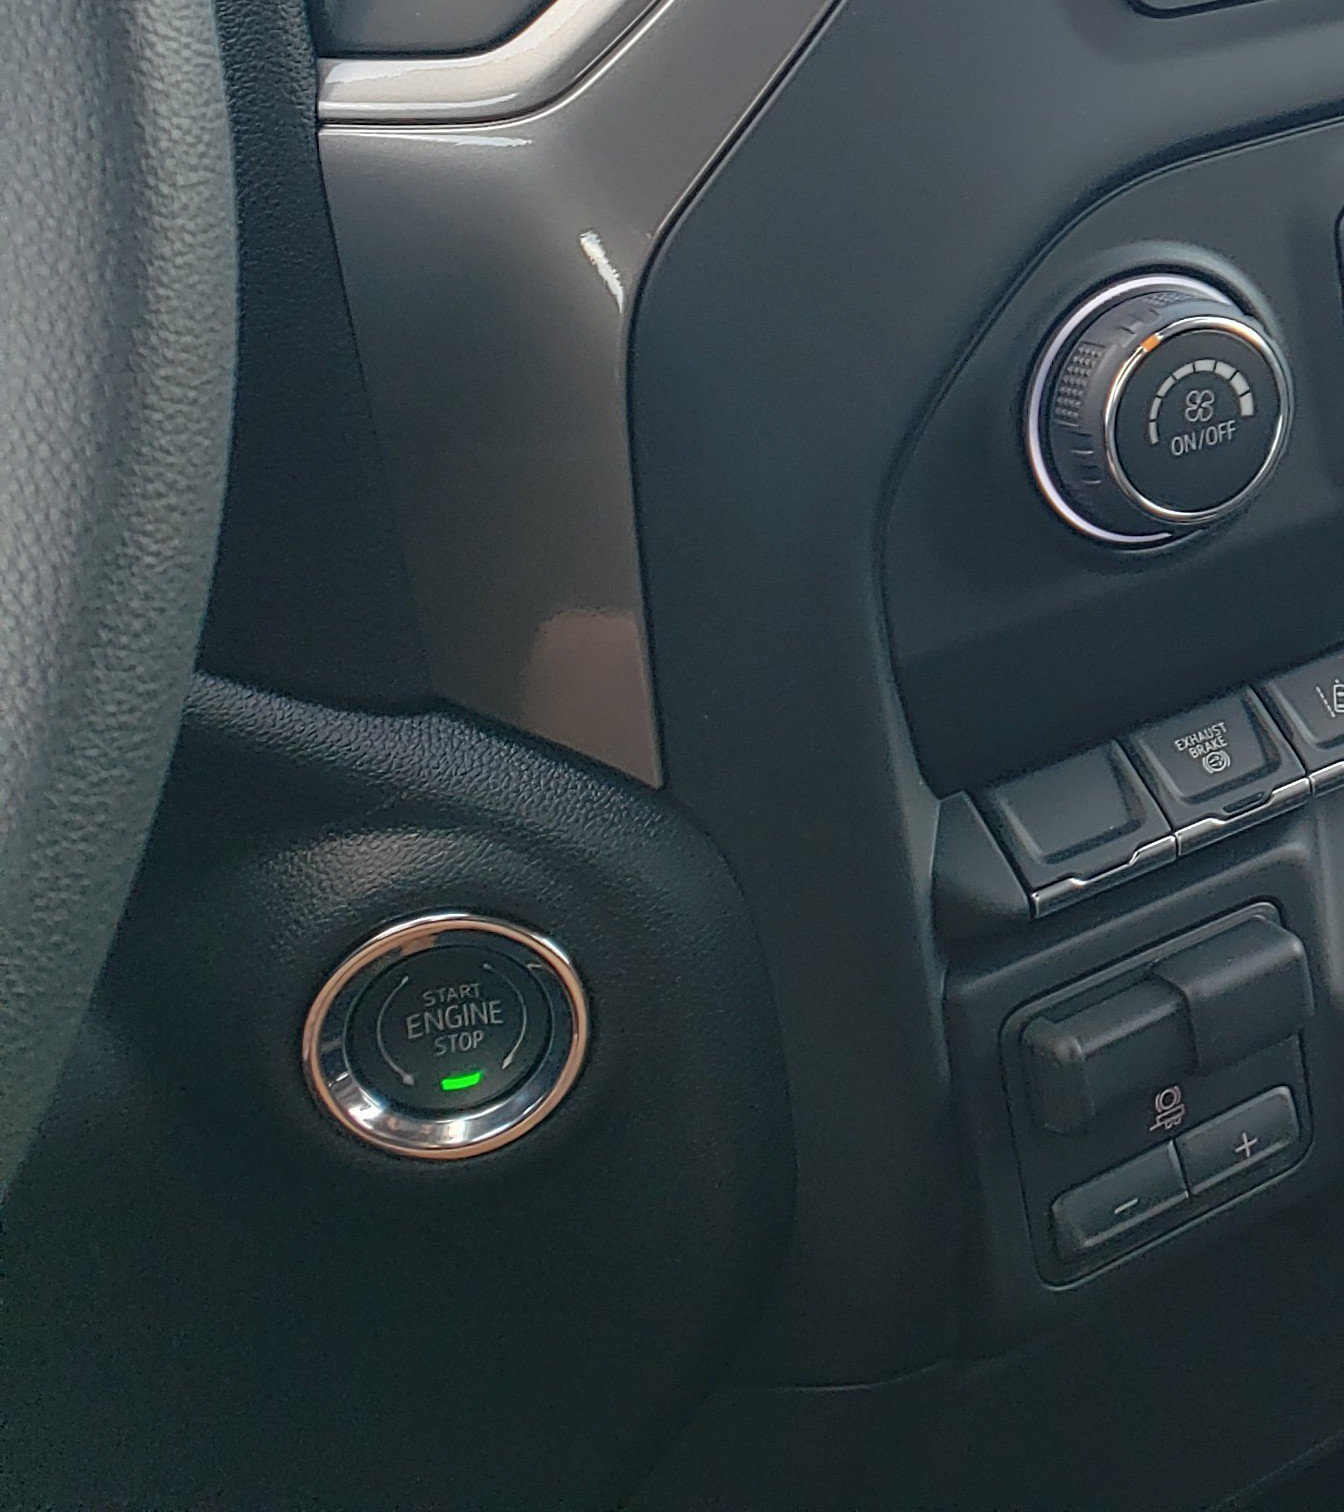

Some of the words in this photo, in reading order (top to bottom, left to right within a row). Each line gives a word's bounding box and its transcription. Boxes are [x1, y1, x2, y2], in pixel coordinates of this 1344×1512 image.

[1171, 420, 1237, 457] ON/OFF
[1174, 722, 1227, 751] EXHAUST
[1188, 735, 1228, 759] BRAKE
[422, 983, 480, 1008] START
[405, 1000, 504, 1039] ENGINE
[434, 1029, 486, 1056] STOP
